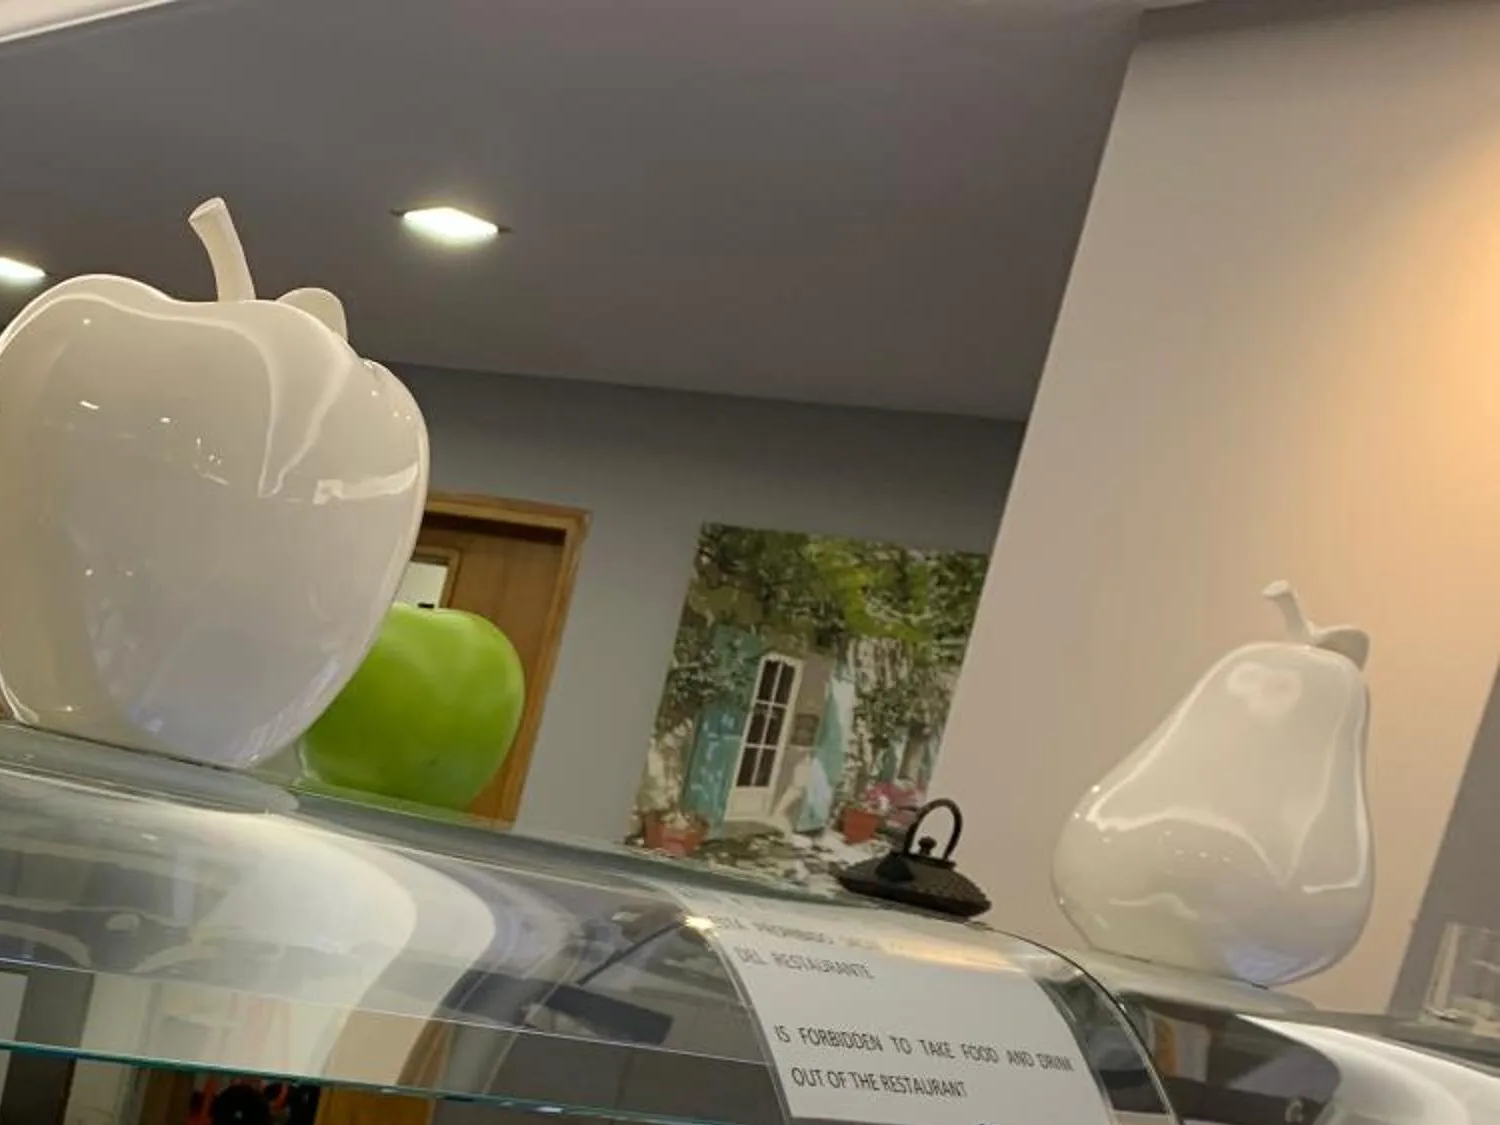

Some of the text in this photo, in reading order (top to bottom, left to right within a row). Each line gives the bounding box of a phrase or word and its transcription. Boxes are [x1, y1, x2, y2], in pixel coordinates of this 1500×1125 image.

[774, 1025, 1076, 1072] IS FORBIDDEN TO TAKE FOOD AND DRINK
[791, 1067, 968, 1097] OUT OF THE RESTAURANT
